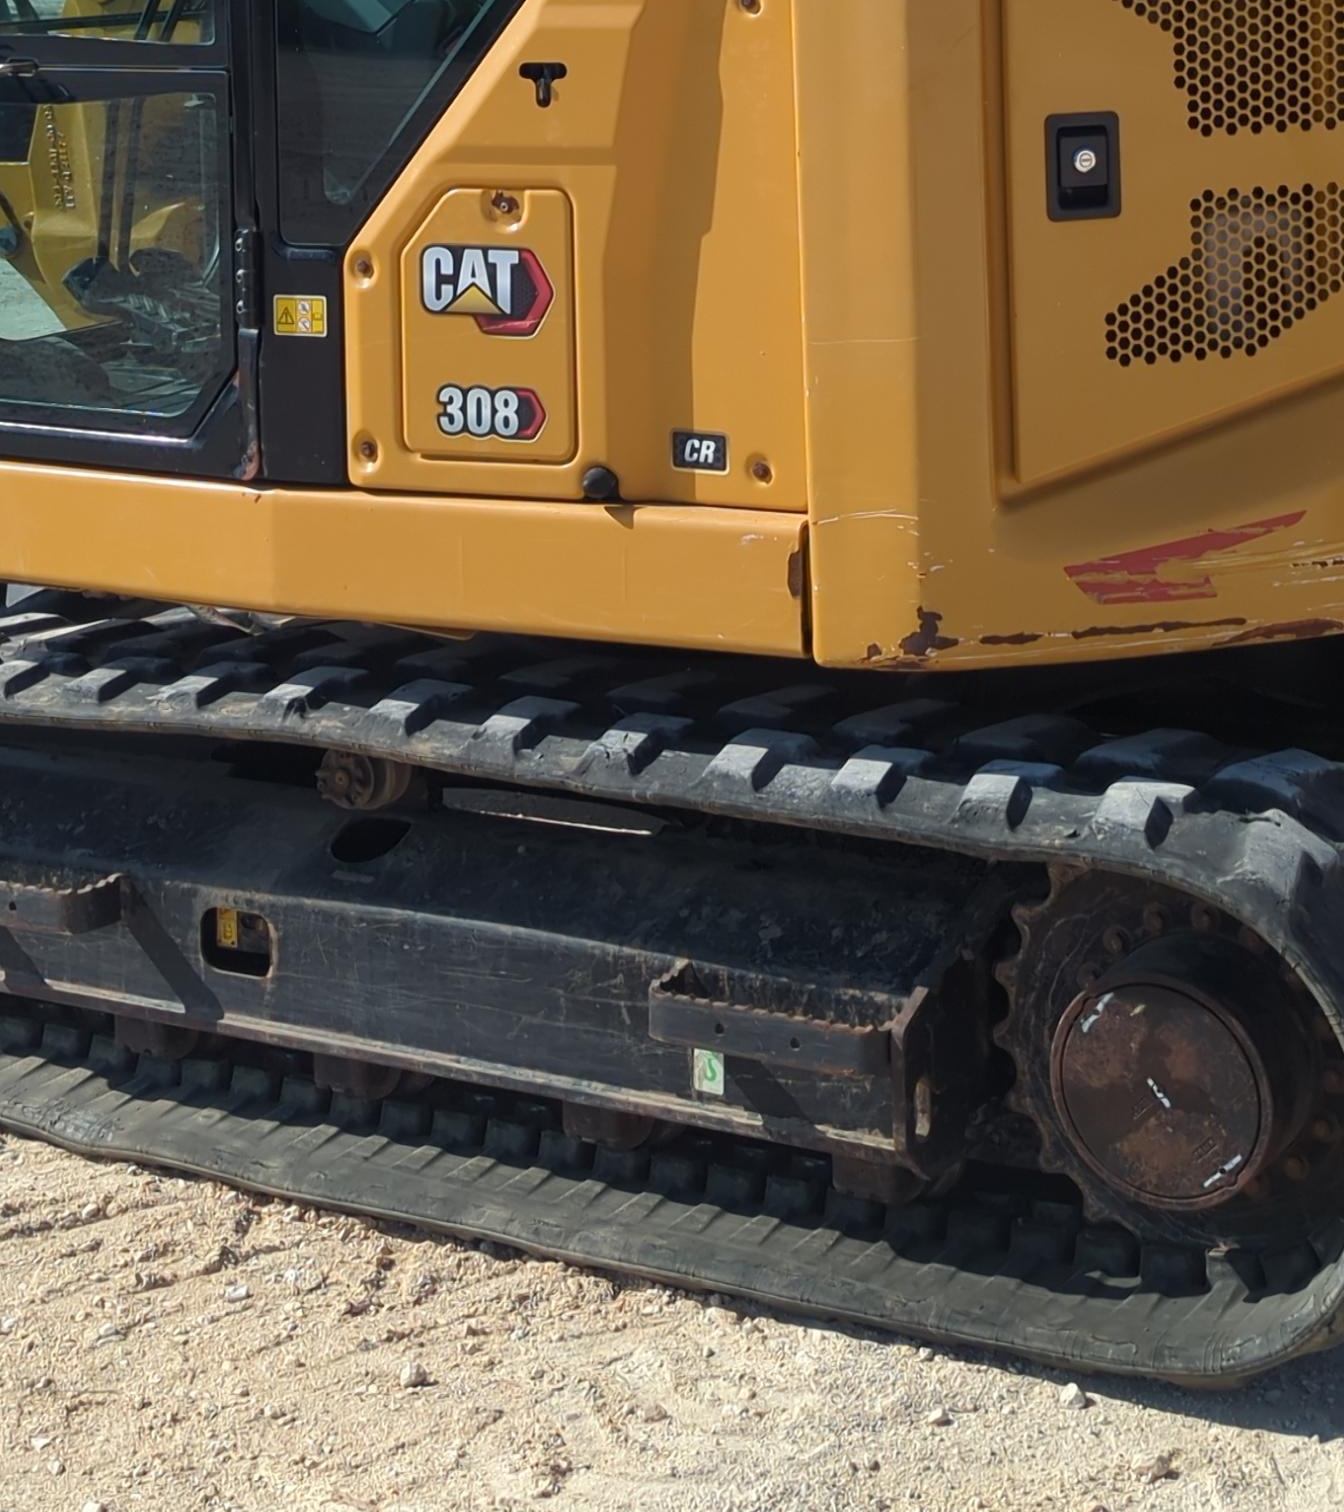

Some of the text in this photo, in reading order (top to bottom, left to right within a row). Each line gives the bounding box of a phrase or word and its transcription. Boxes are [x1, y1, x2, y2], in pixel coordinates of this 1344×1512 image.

[422, 245, 520, 316] CAT
[438, 385, 520, 437] 308
[683, 437, 716, 464] CR
